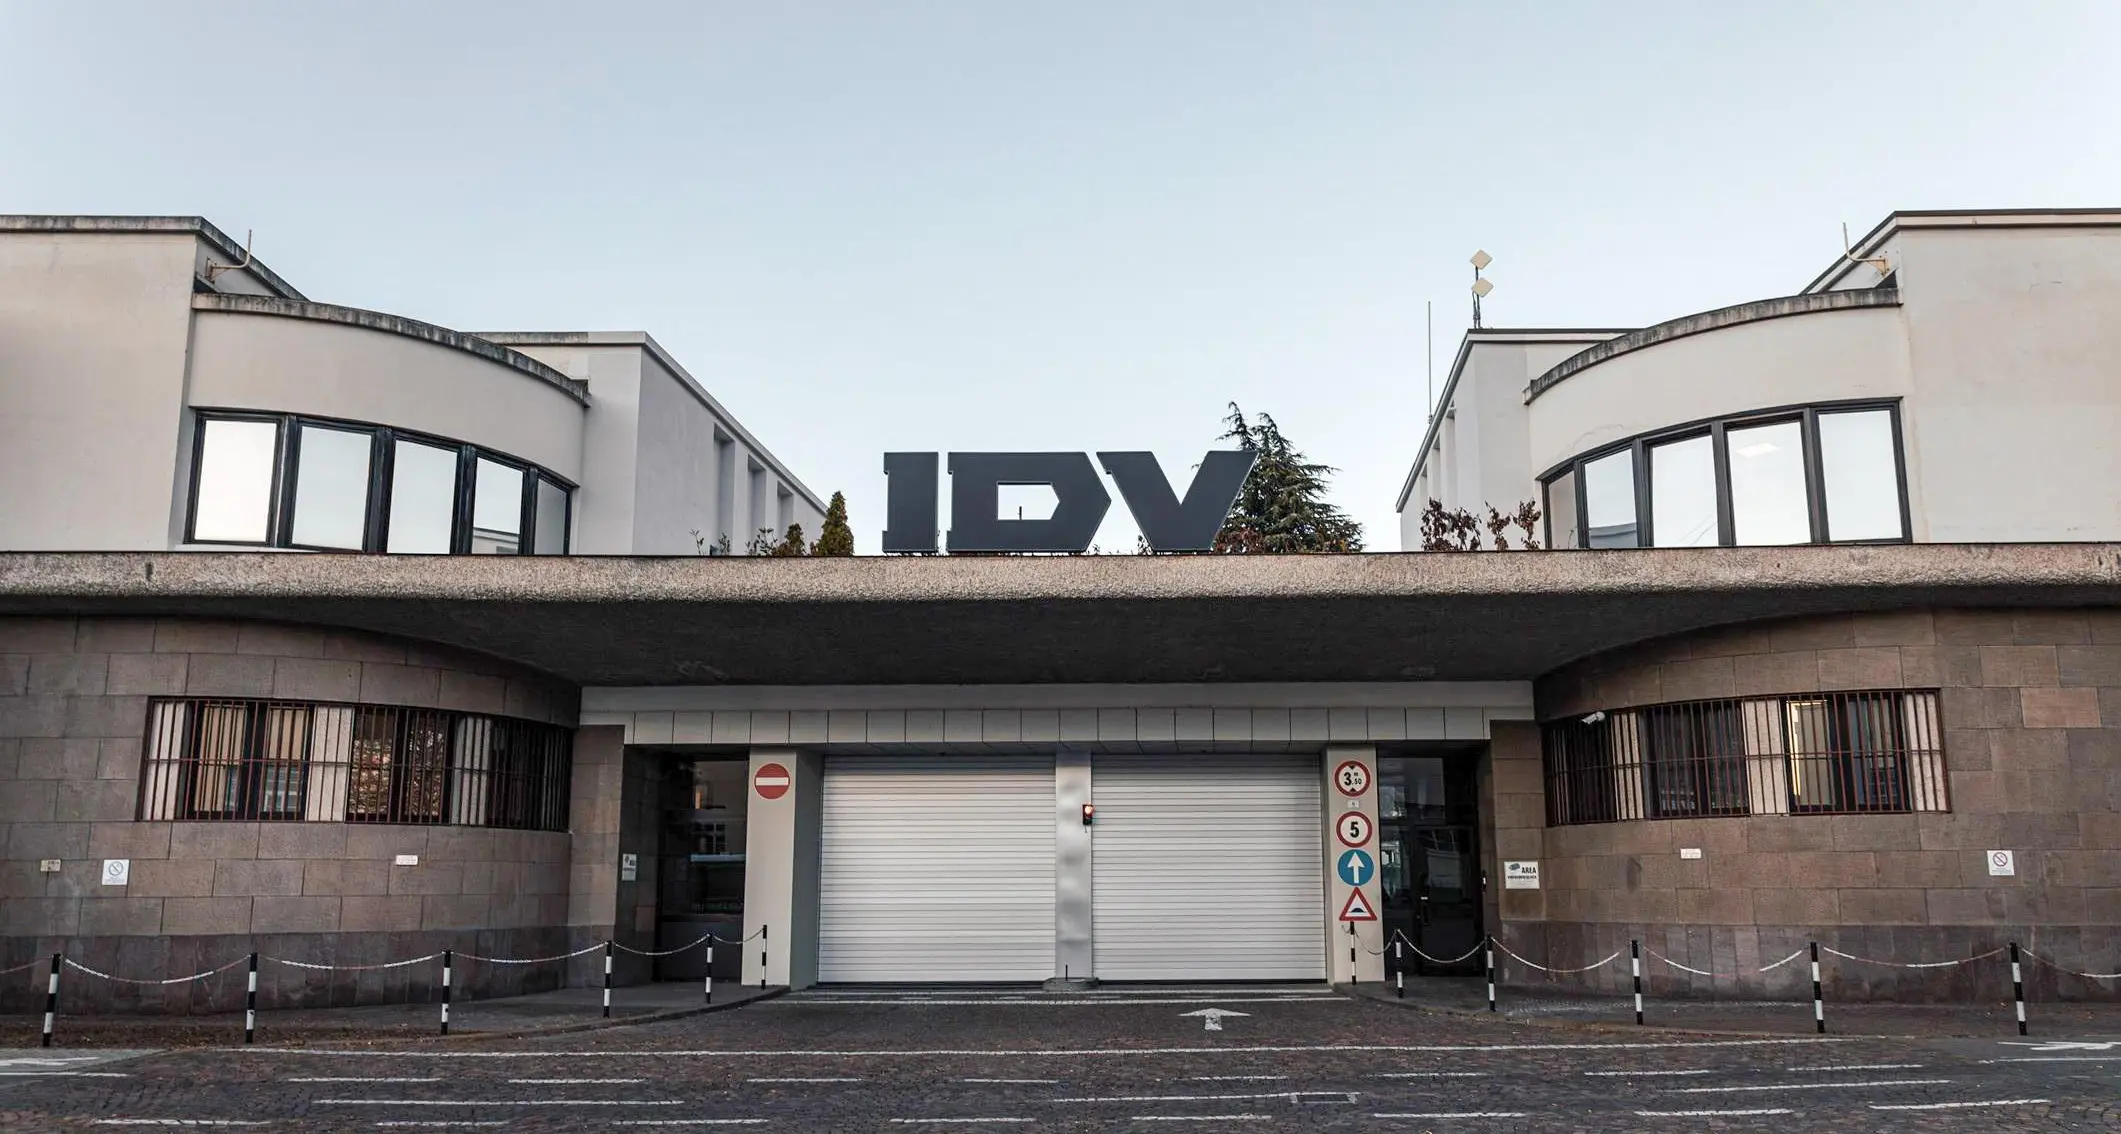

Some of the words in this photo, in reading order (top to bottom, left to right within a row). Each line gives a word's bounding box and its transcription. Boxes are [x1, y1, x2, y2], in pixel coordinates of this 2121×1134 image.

[882, 451, 1260, 553] IDV
[1349, 821, 1360, 838] 5
[1521, 866, 1537, 874] AREA
